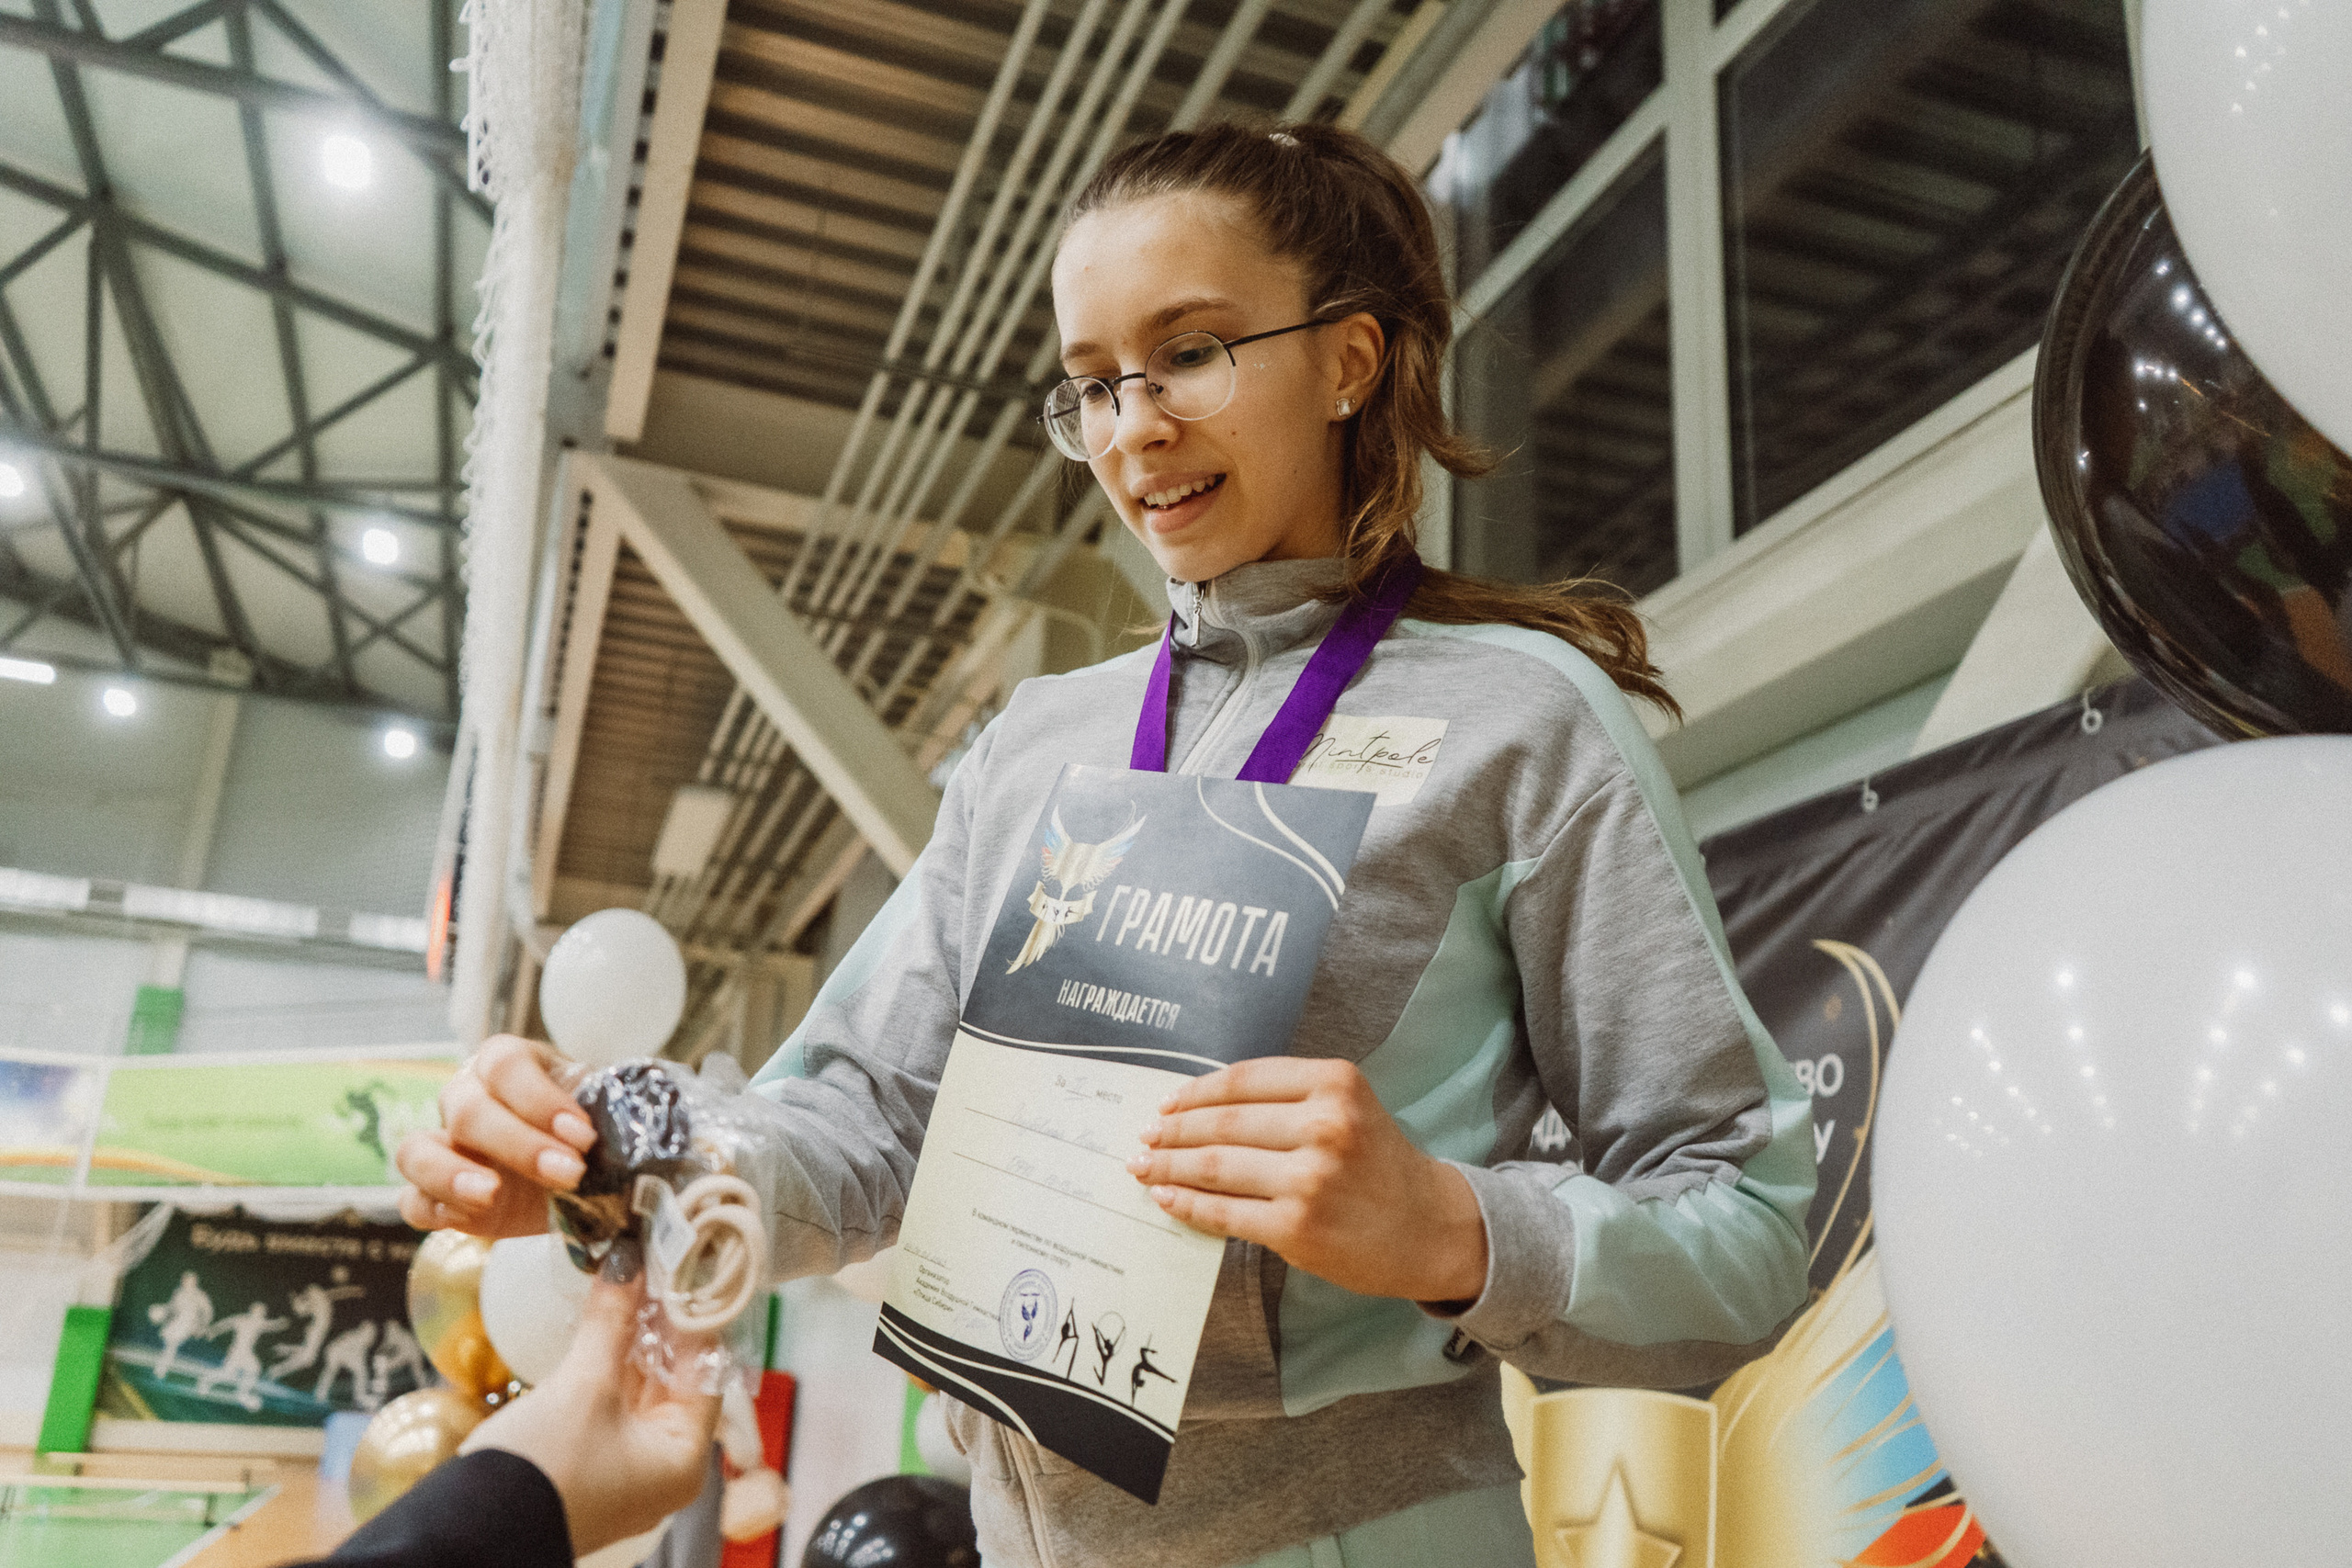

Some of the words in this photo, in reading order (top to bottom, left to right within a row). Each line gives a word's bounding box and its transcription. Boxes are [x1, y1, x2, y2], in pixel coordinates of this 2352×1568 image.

[1379, 768, 1423, 779] studio
[1095, 885, 1289, 977] ГРАМОТА
[1057, 978, 1182, 1032] НАГРАЖДАЕТСЯ
[1794, 1054, 1844, 1097] ВО
